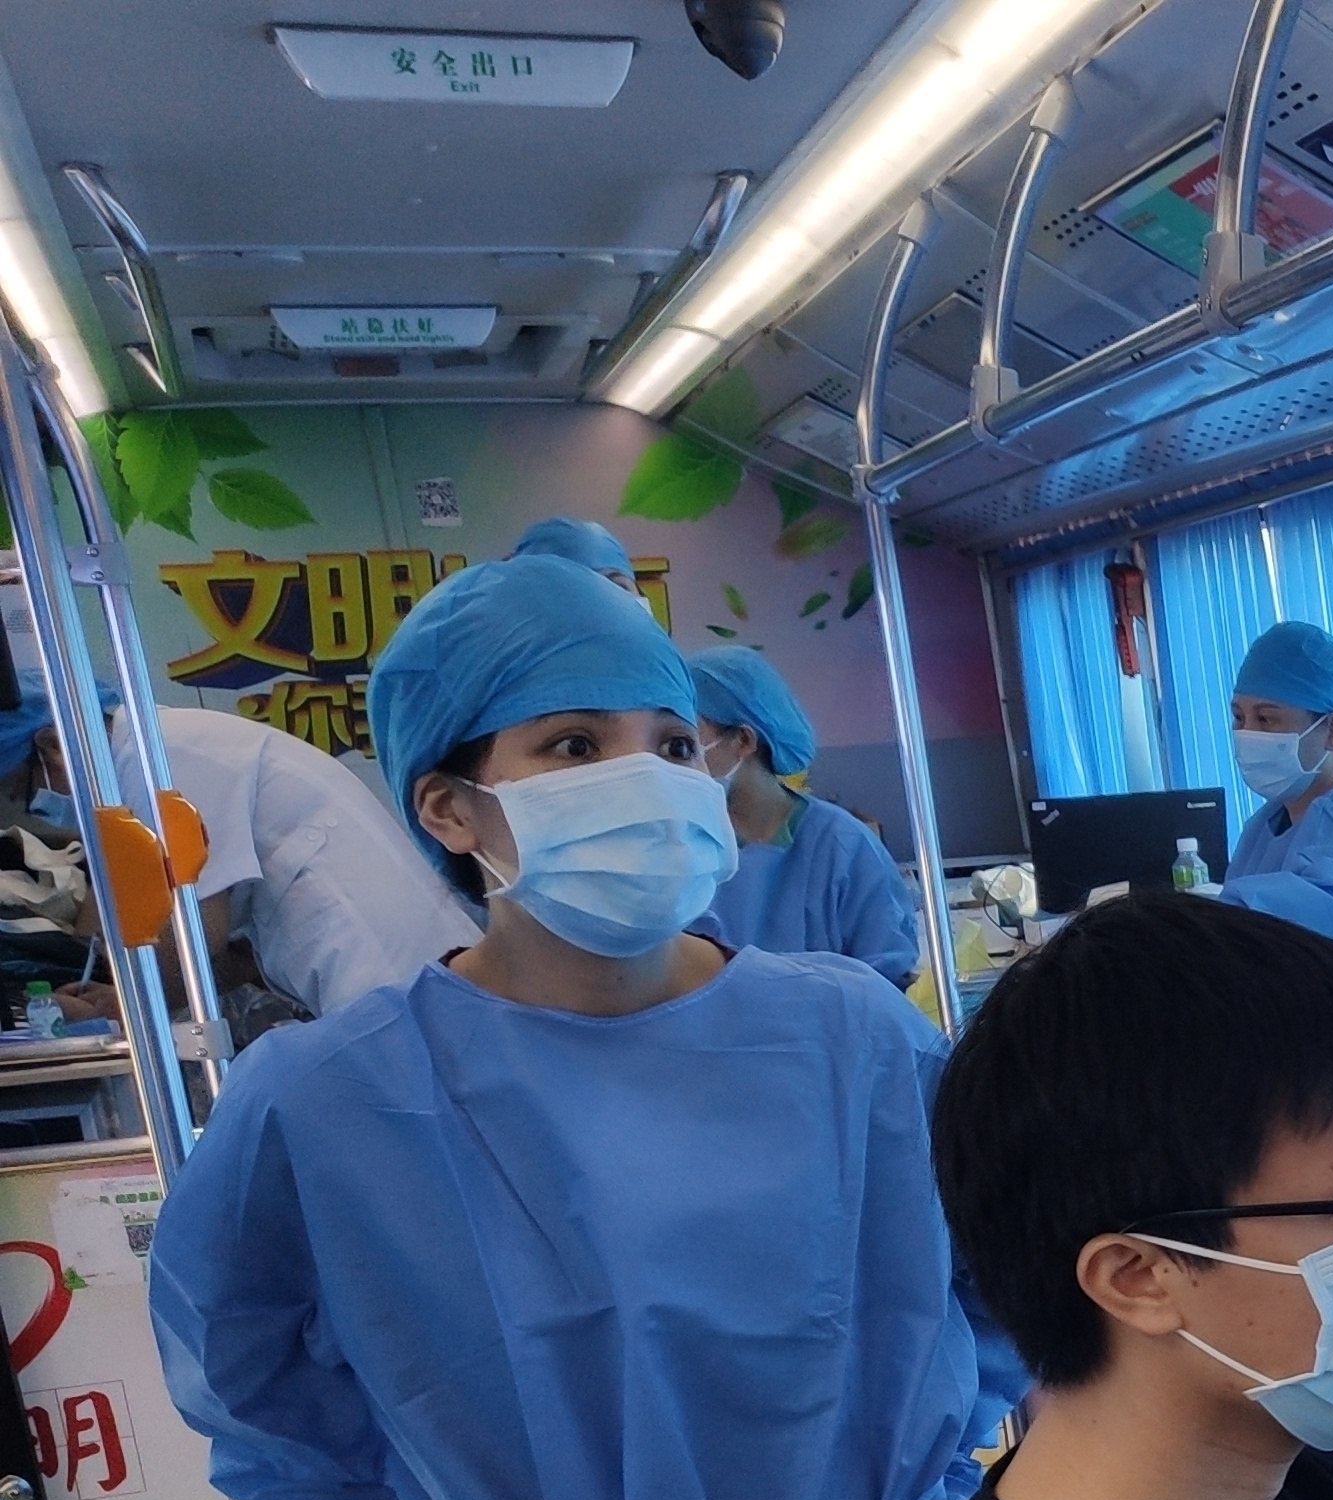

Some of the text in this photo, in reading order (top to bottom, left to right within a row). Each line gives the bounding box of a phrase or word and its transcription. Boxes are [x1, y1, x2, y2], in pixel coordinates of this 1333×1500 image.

[390, 47, 533, 78] 安全出口
[450, 80, 480, 93] Exit
